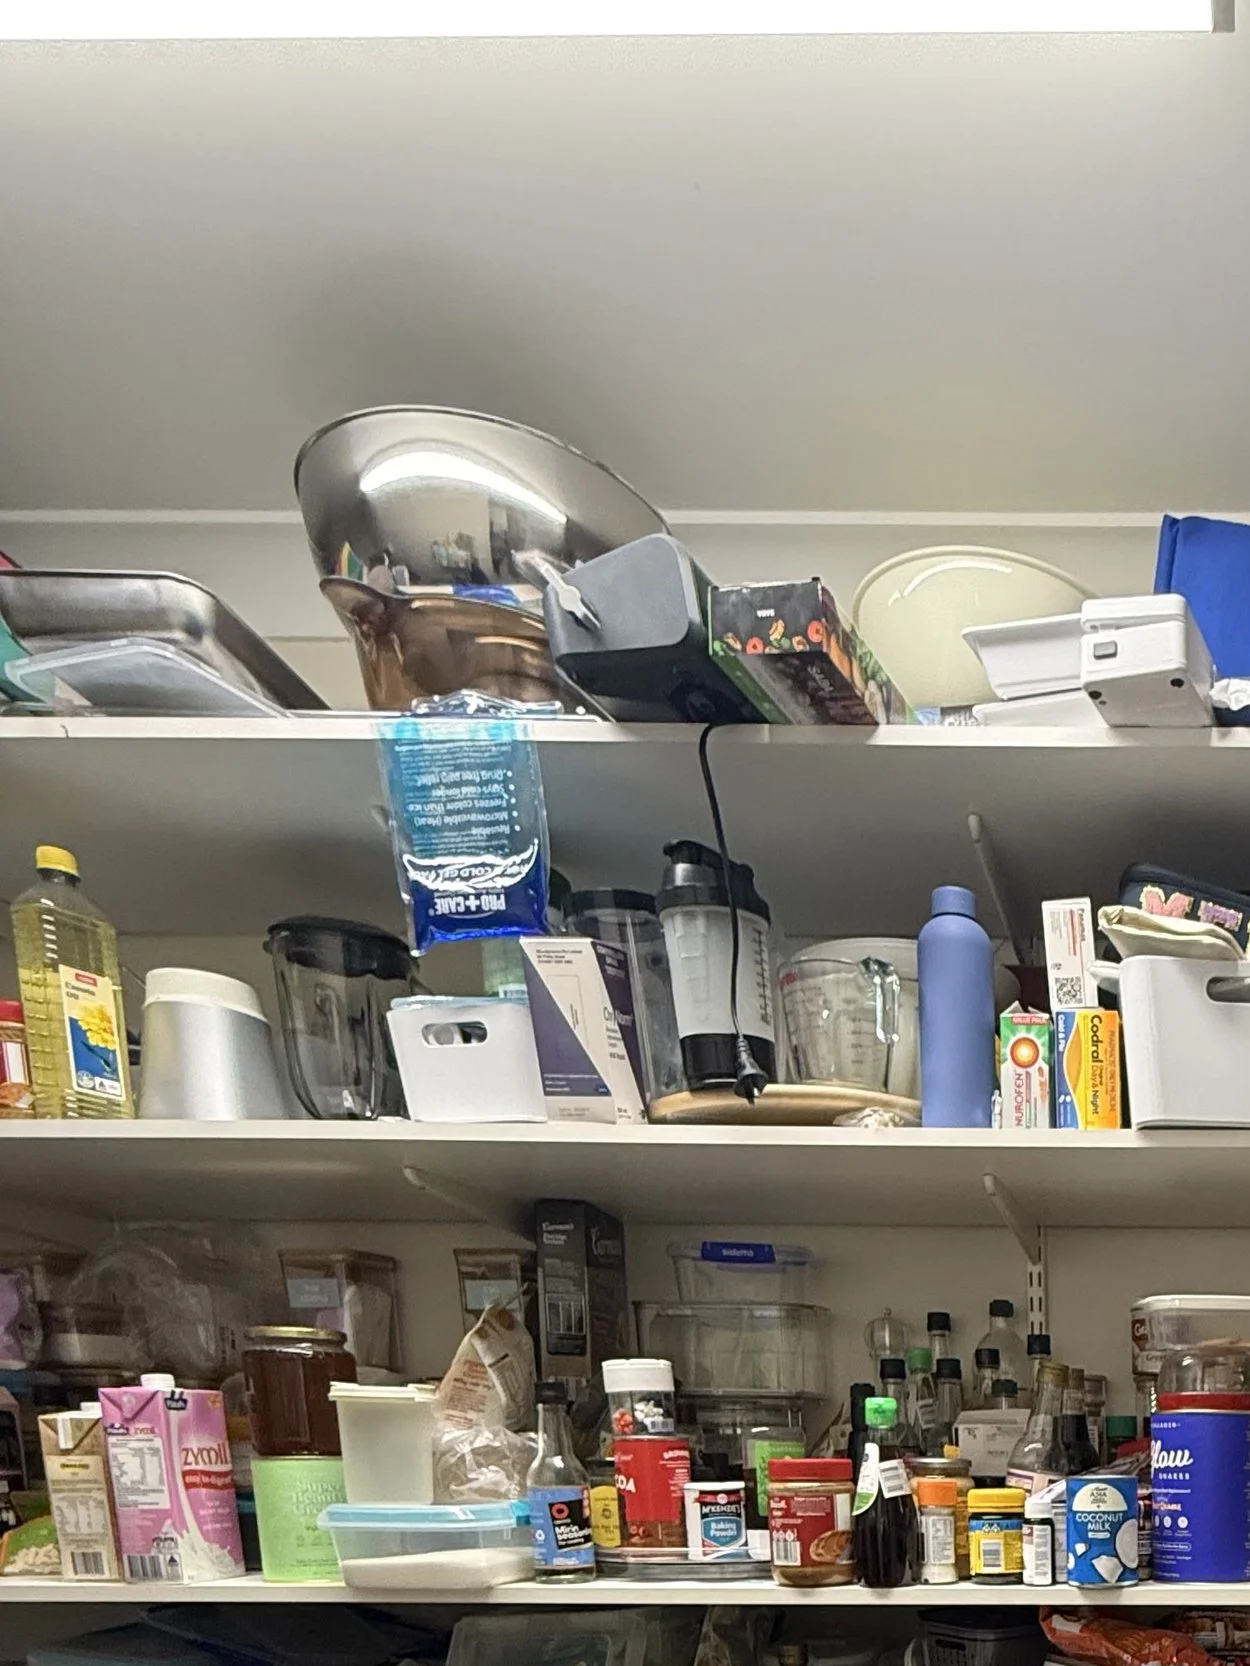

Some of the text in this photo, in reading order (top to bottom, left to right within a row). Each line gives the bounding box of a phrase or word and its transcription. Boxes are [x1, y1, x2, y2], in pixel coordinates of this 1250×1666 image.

[425, 802, 445, 815] than
[446, 799, 472, 810] colder
[474, 798, 507, 808] Freezes
[413, 811, 509, 827] Microwaveable (Heat)
[1056, 1014, 1066, 1032] Cold
[1090, 1014, 1104, 1064] Codral
[1014, 1072, 1025, 1128] NUROFEN
[1090, 1090, 1101, 1115] Night
[722, 1248, 754, 1257] sistema
[1076, 1512, 1124, 1523] COCONUT
[555, 1525, 580, 1537] Mirin
[711, 1522, 736, 1532] Baking
[1087, 1521, 1112, 1531] MILK
[710, 1530, 737, 1539] Powder
